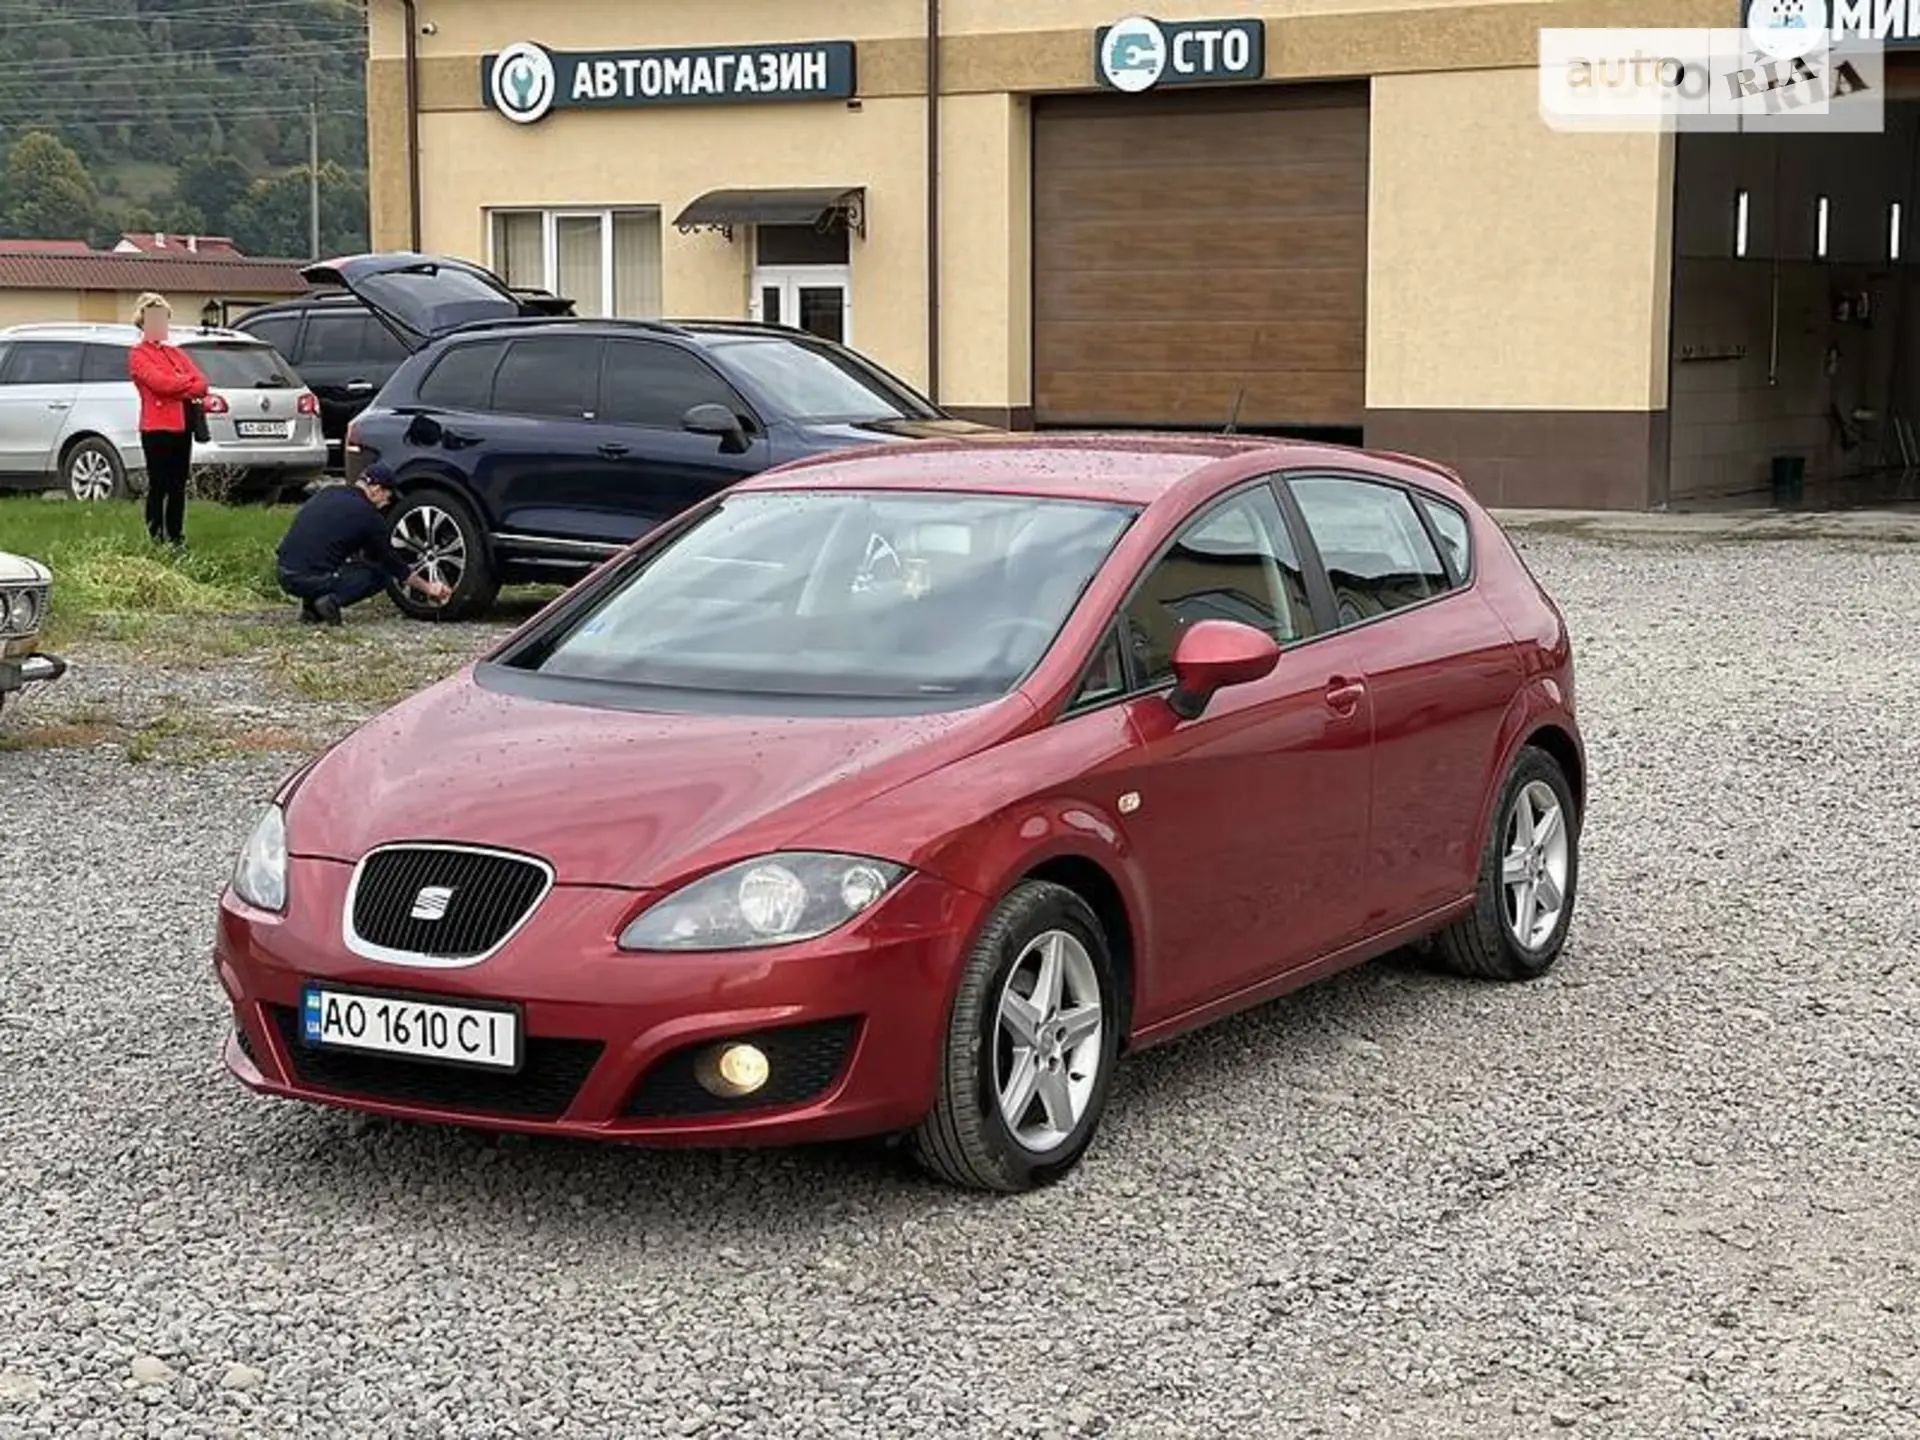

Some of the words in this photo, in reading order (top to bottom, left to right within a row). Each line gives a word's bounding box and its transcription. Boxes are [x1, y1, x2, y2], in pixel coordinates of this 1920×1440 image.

[1173, 28, 1249, 73] СТО
[571, 51, 827, 99] АВТОМАГАЗИН
[324, 998, 367, 1038] AO
[377, 1005, 447, 1050] 1610
[457, 1015, 496, 1056] CI
